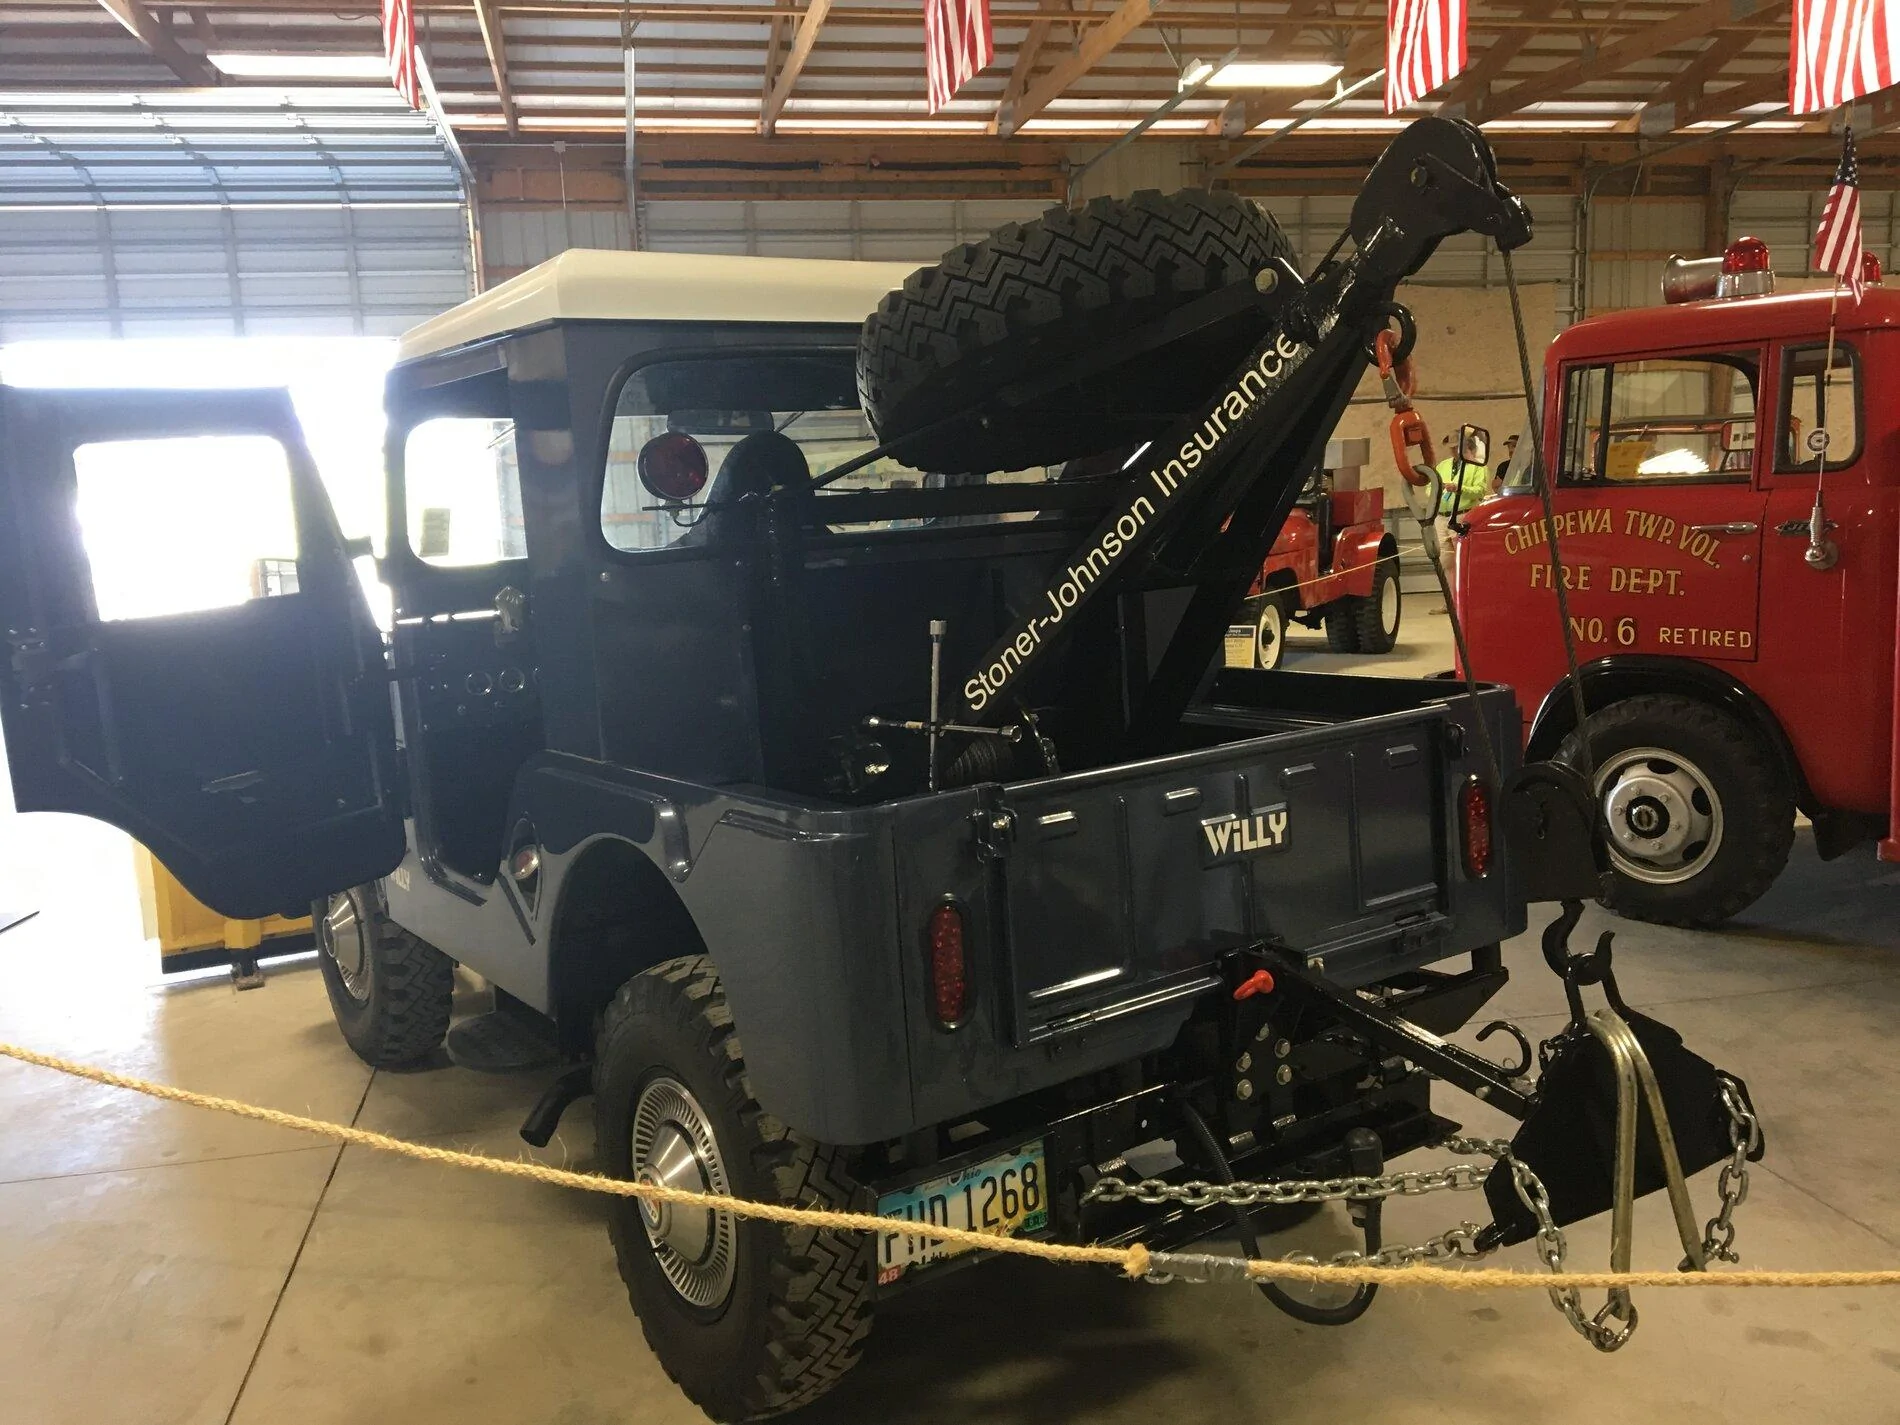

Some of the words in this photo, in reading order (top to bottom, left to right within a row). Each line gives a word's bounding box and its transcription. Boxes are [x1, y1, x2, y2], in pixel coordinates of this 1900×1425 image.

[964, 496, 1156, 712] Stoner-Johnson
[1150, 332, 1301, 497] Insurance
[1504, 508, 1613, 555] CHIPPEWA
[1624, 509, 1676, 545] TWP.
[1678, 524, 1722, 570] VOL.
[1530, 563, 1591, 591] FIRE
[1609, 566, 1685, 596] DEPT.
[1569, 616, 1608, 643] NO.
[1617, 617, 1636, 646] 6
[1658, 627, 1752, 648] RETIRED
[962, 1161, 1043, 1233] 1268
